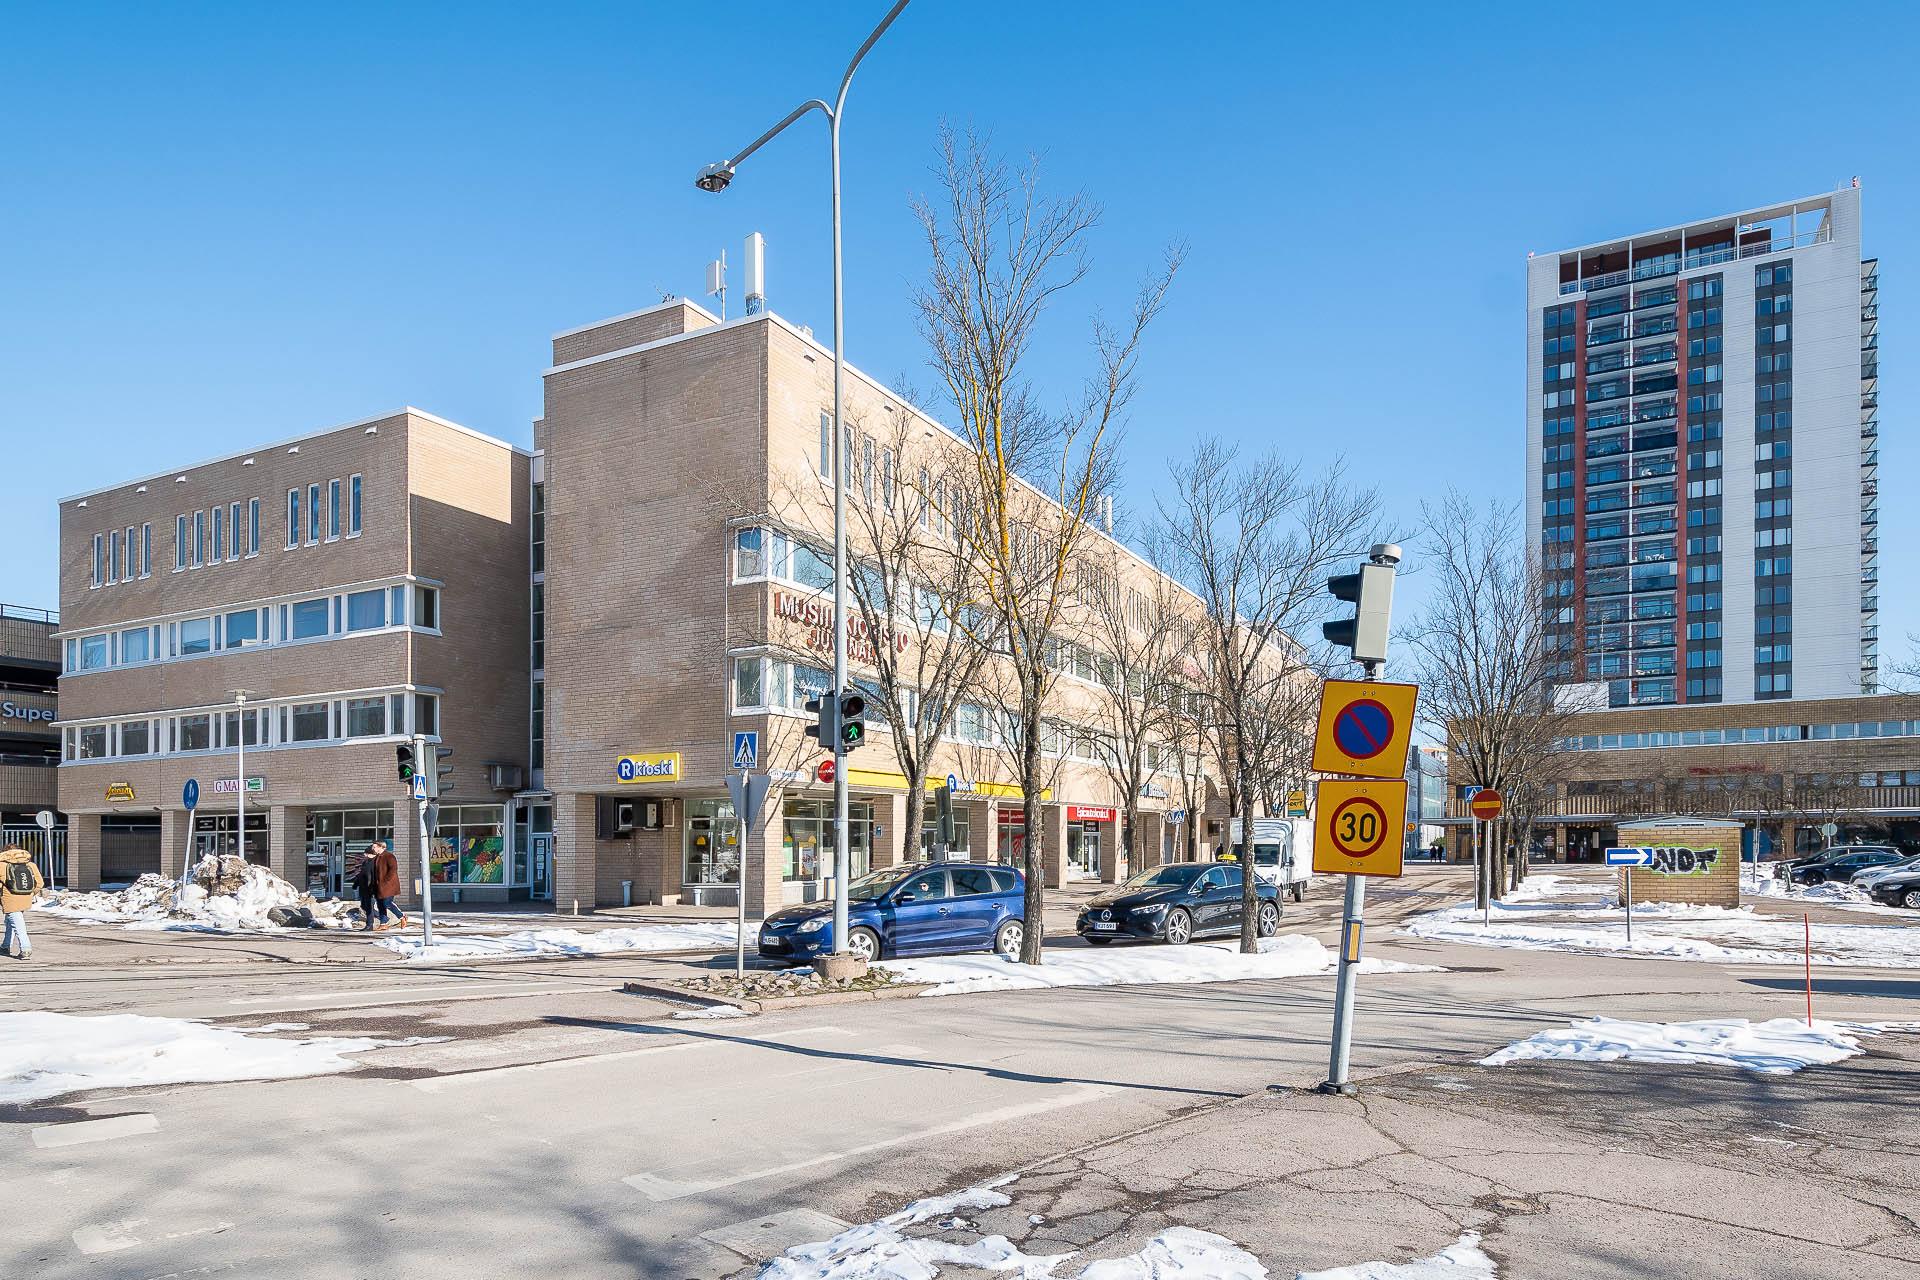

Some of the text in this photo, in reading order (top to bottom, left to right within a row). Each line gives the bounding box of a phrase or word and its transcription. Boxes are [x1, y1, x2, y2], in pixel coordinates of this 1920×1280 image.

[635, 760, 675, 776] kioski
[215, 781, 221, 792] G
[222, 780, 249, 791] MAT
[1340, 812, 1376, 843] 30
